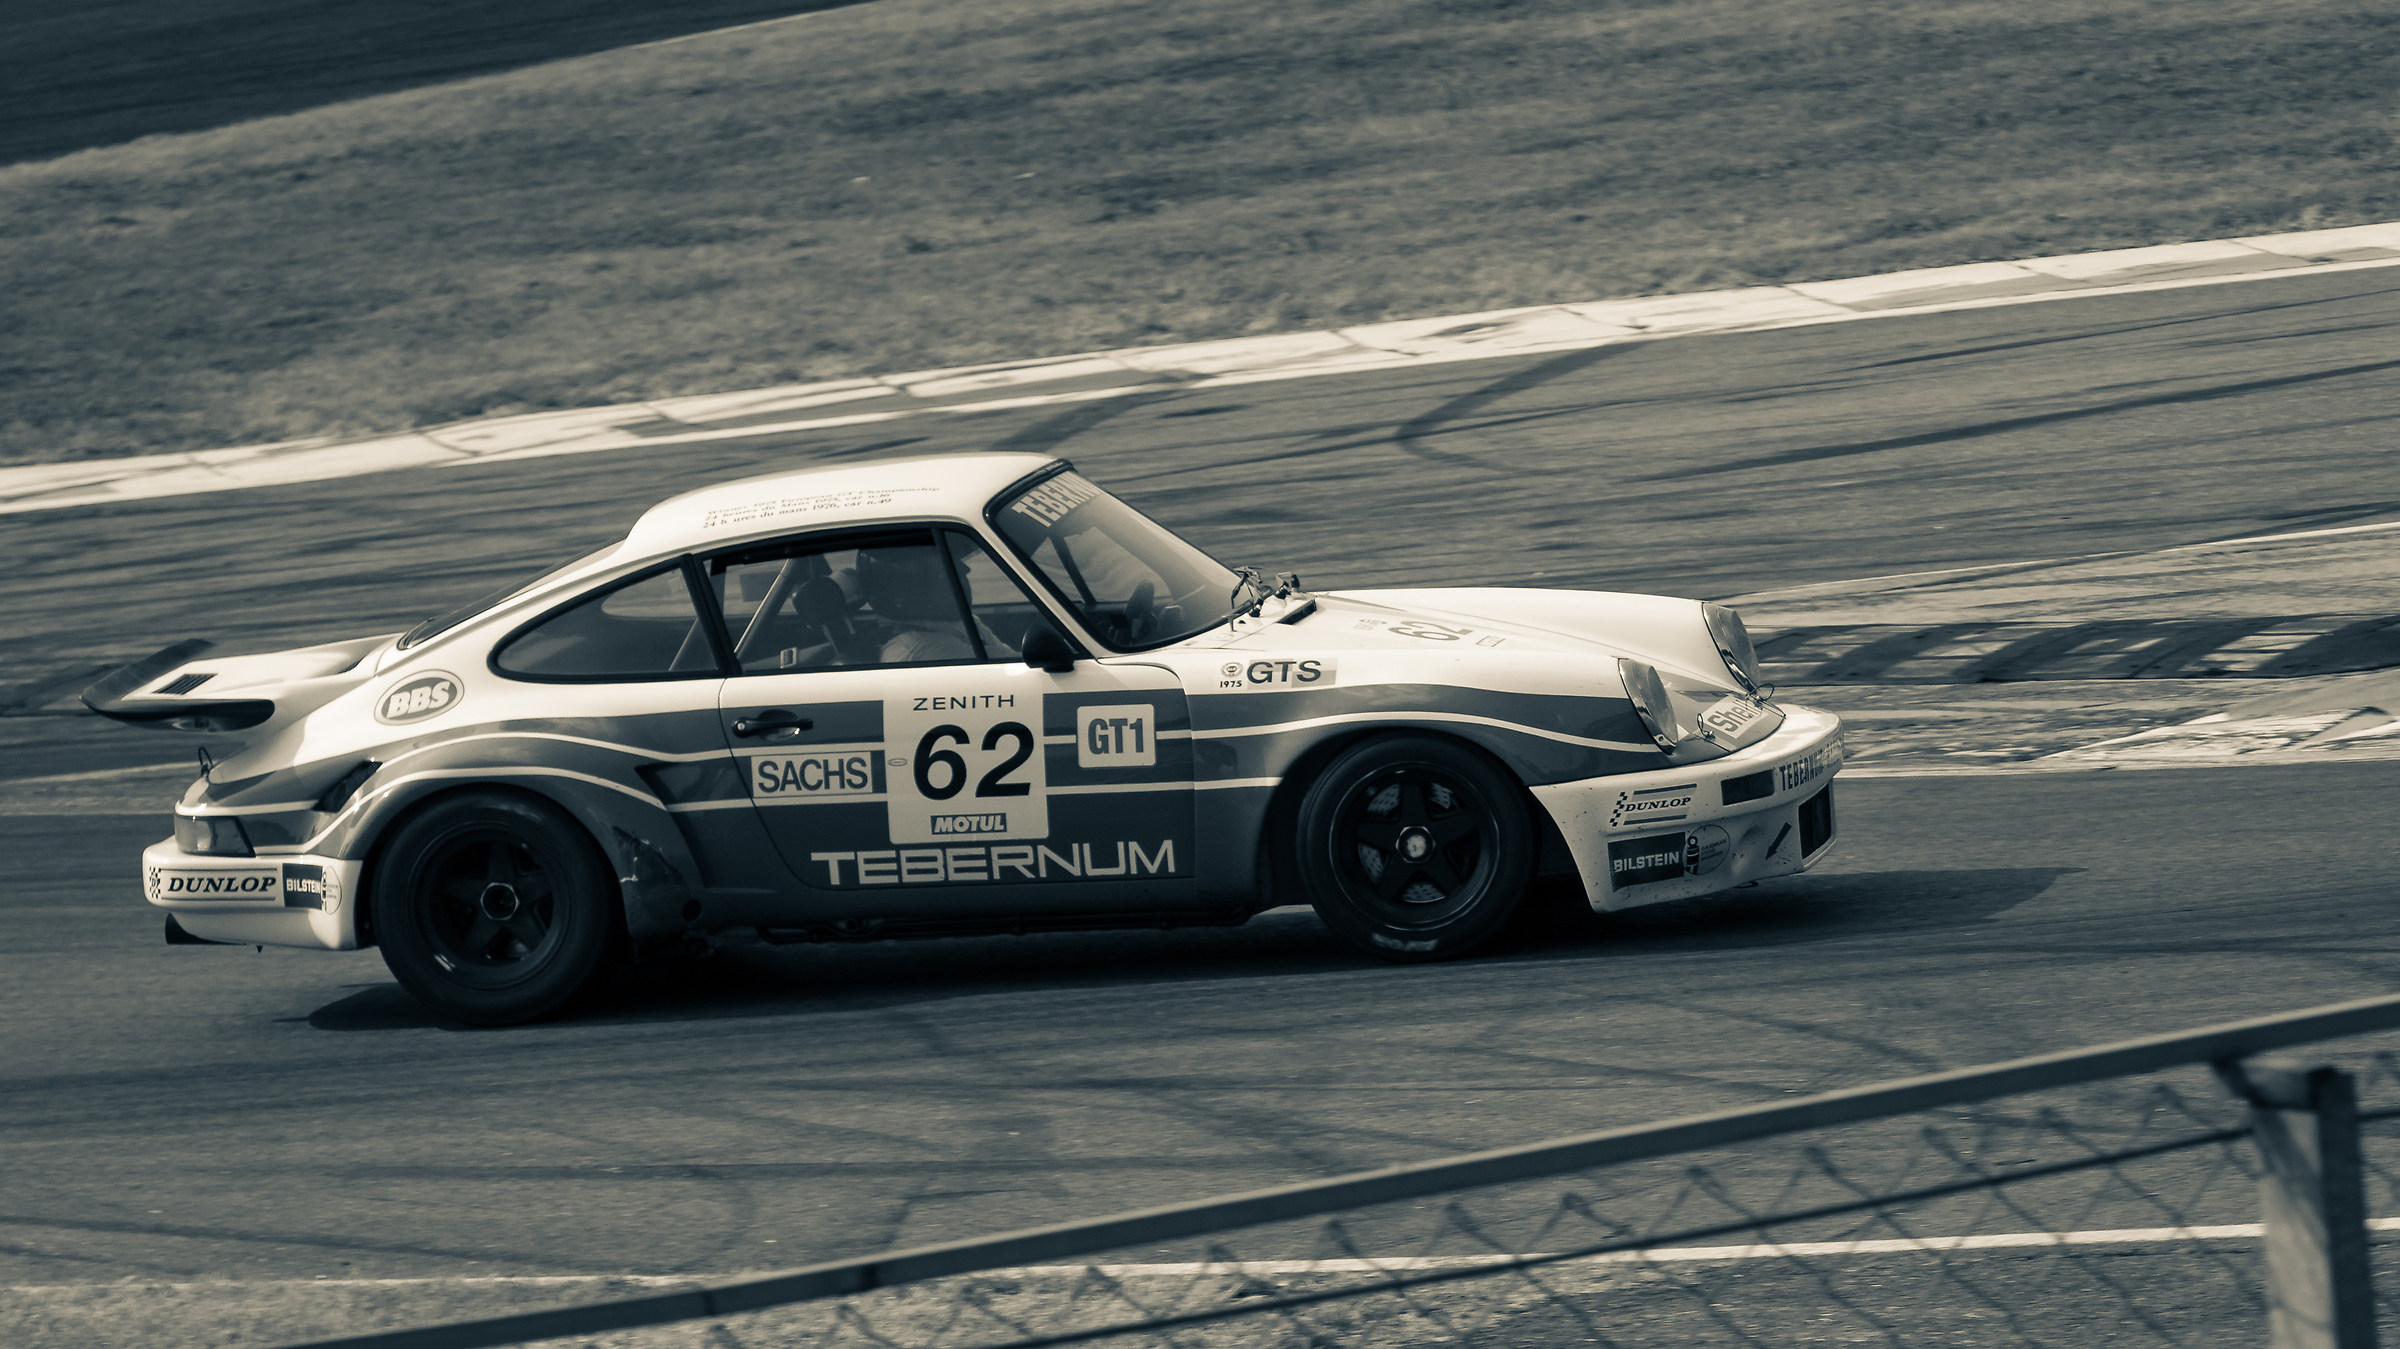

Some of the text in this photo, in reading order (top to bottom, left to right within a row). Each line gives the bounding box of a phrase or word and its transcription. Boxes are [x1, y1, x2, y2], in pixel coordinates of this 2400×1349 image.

[858, 487, 941, 495] Championship
[703, 520, 716, 529] 24
[760, 511, 774, 519] du
[778, 507, 808, 515] mans
[1388, 620, 1473, 641] 62
[1246, 660, 1322, 684] GTS
[1219, 680, 1243, 689] 1975
[386, 681, 450, 719] BBS
[913, 694, 1015, 711] ZENITH
[1087, 717, 1146, 755] GT1
[913, 721, 1035, 801] 62
[757, 757, 869, 793] SACHS
[1624, 797, 1692, 812] DUNLOP
[933, 814, 1005, 834] MOTUL
[810, 839, 1176, 886] TEBERNUM
[1613, 851, 1680, 873] BILSTEIN
[168, 876, 277, 893] DUNLOP
